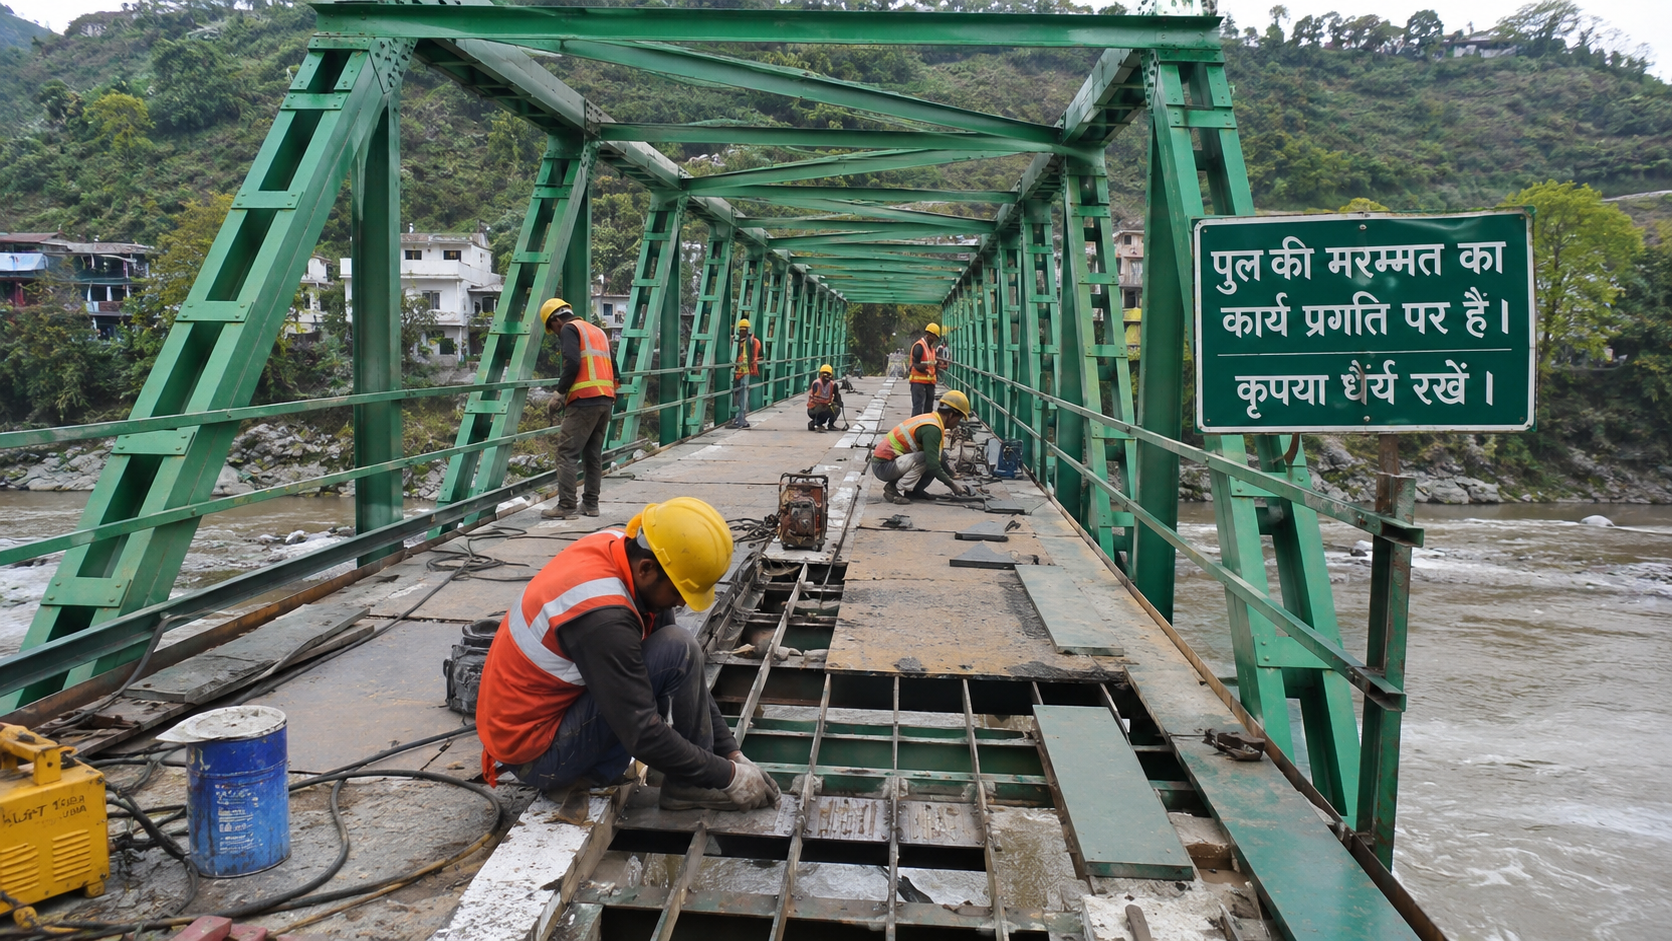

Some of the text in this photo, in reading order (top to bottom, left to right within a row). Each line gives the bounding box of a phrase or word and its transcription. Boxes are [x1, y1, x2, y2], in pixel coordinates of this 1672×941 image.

[1211, 236, 1506, 294] पुल की मरम्मत का
[1220, 292, 1291, 338] कार्य
[1302, 291, 1390, 337] प्रगति
[1402, 302, 1451, 334] पर
[1235, 375, 1329, 418] कृपया
